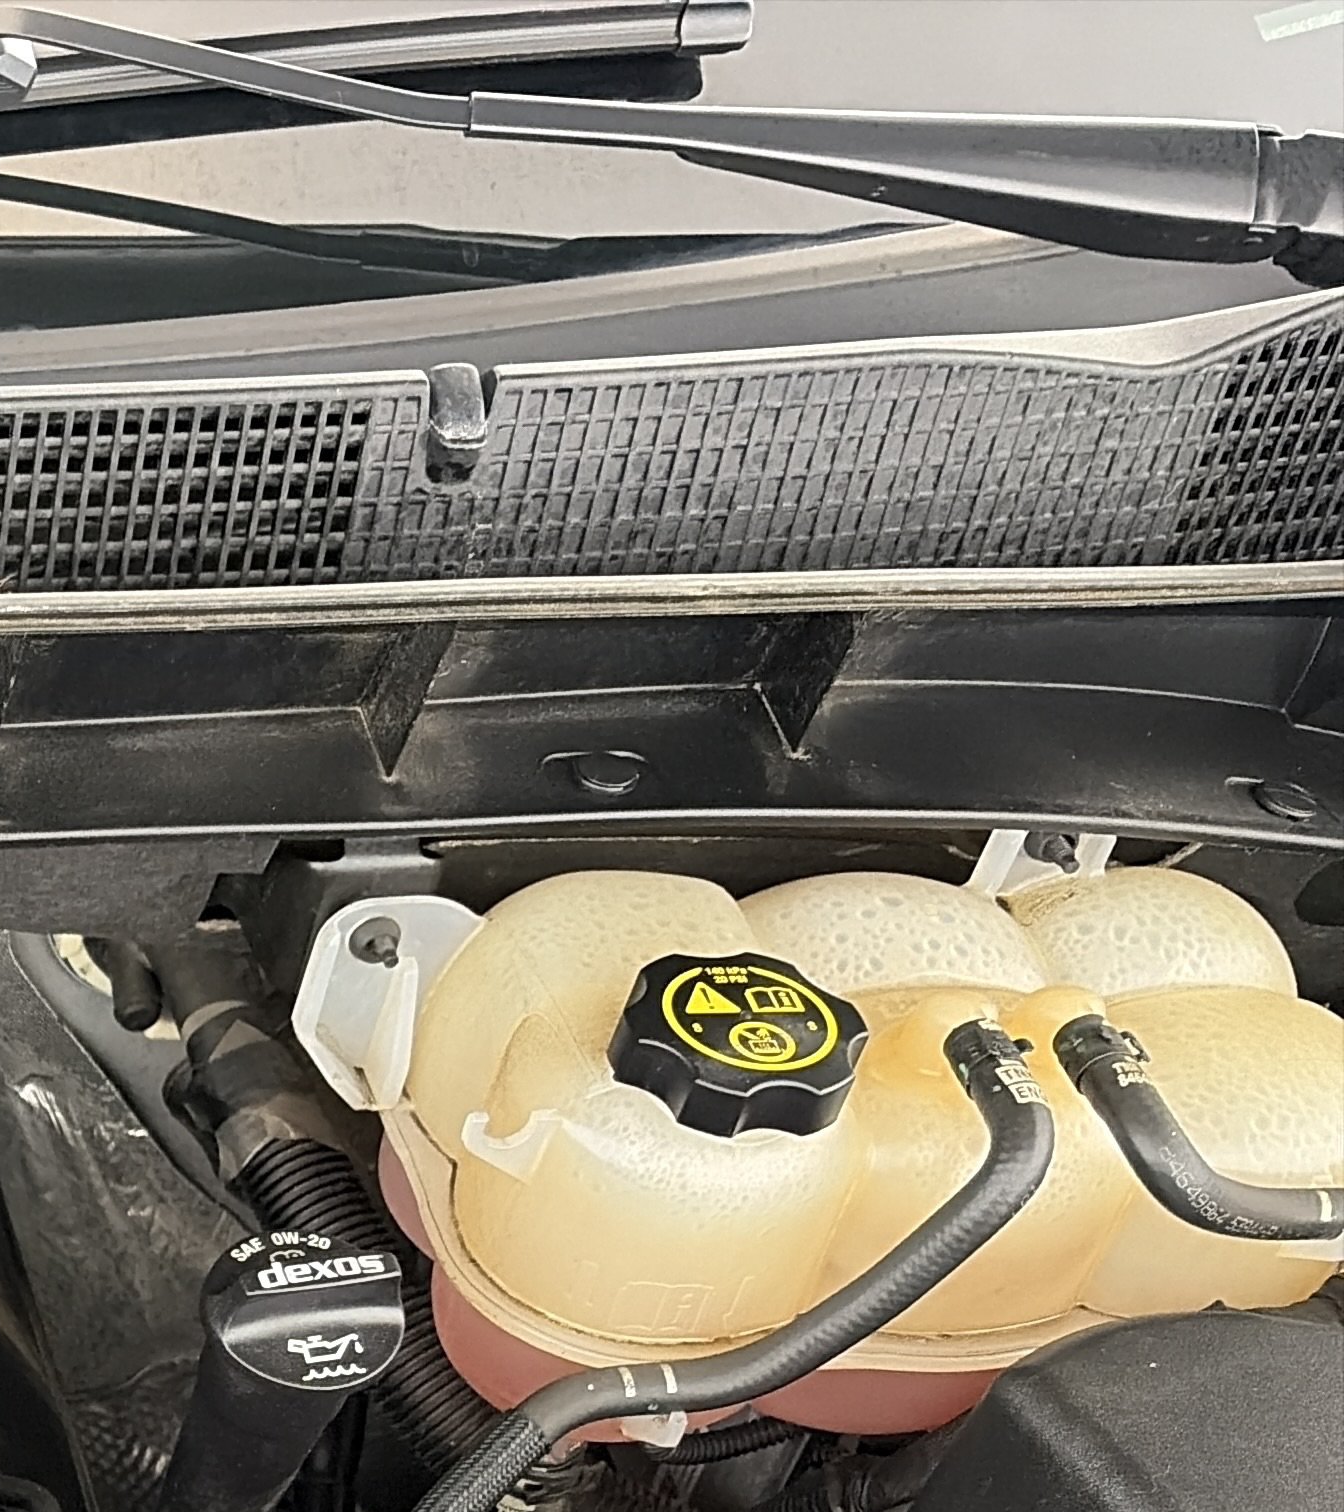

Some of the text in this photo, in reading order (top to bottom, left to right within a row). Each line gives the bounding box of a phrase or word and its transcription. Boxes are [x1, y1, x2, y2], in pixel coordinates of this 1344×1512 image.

[230, 1231, 331, 1262] SAE 0W-20
[257, 1254, 386, 1289] dexos
